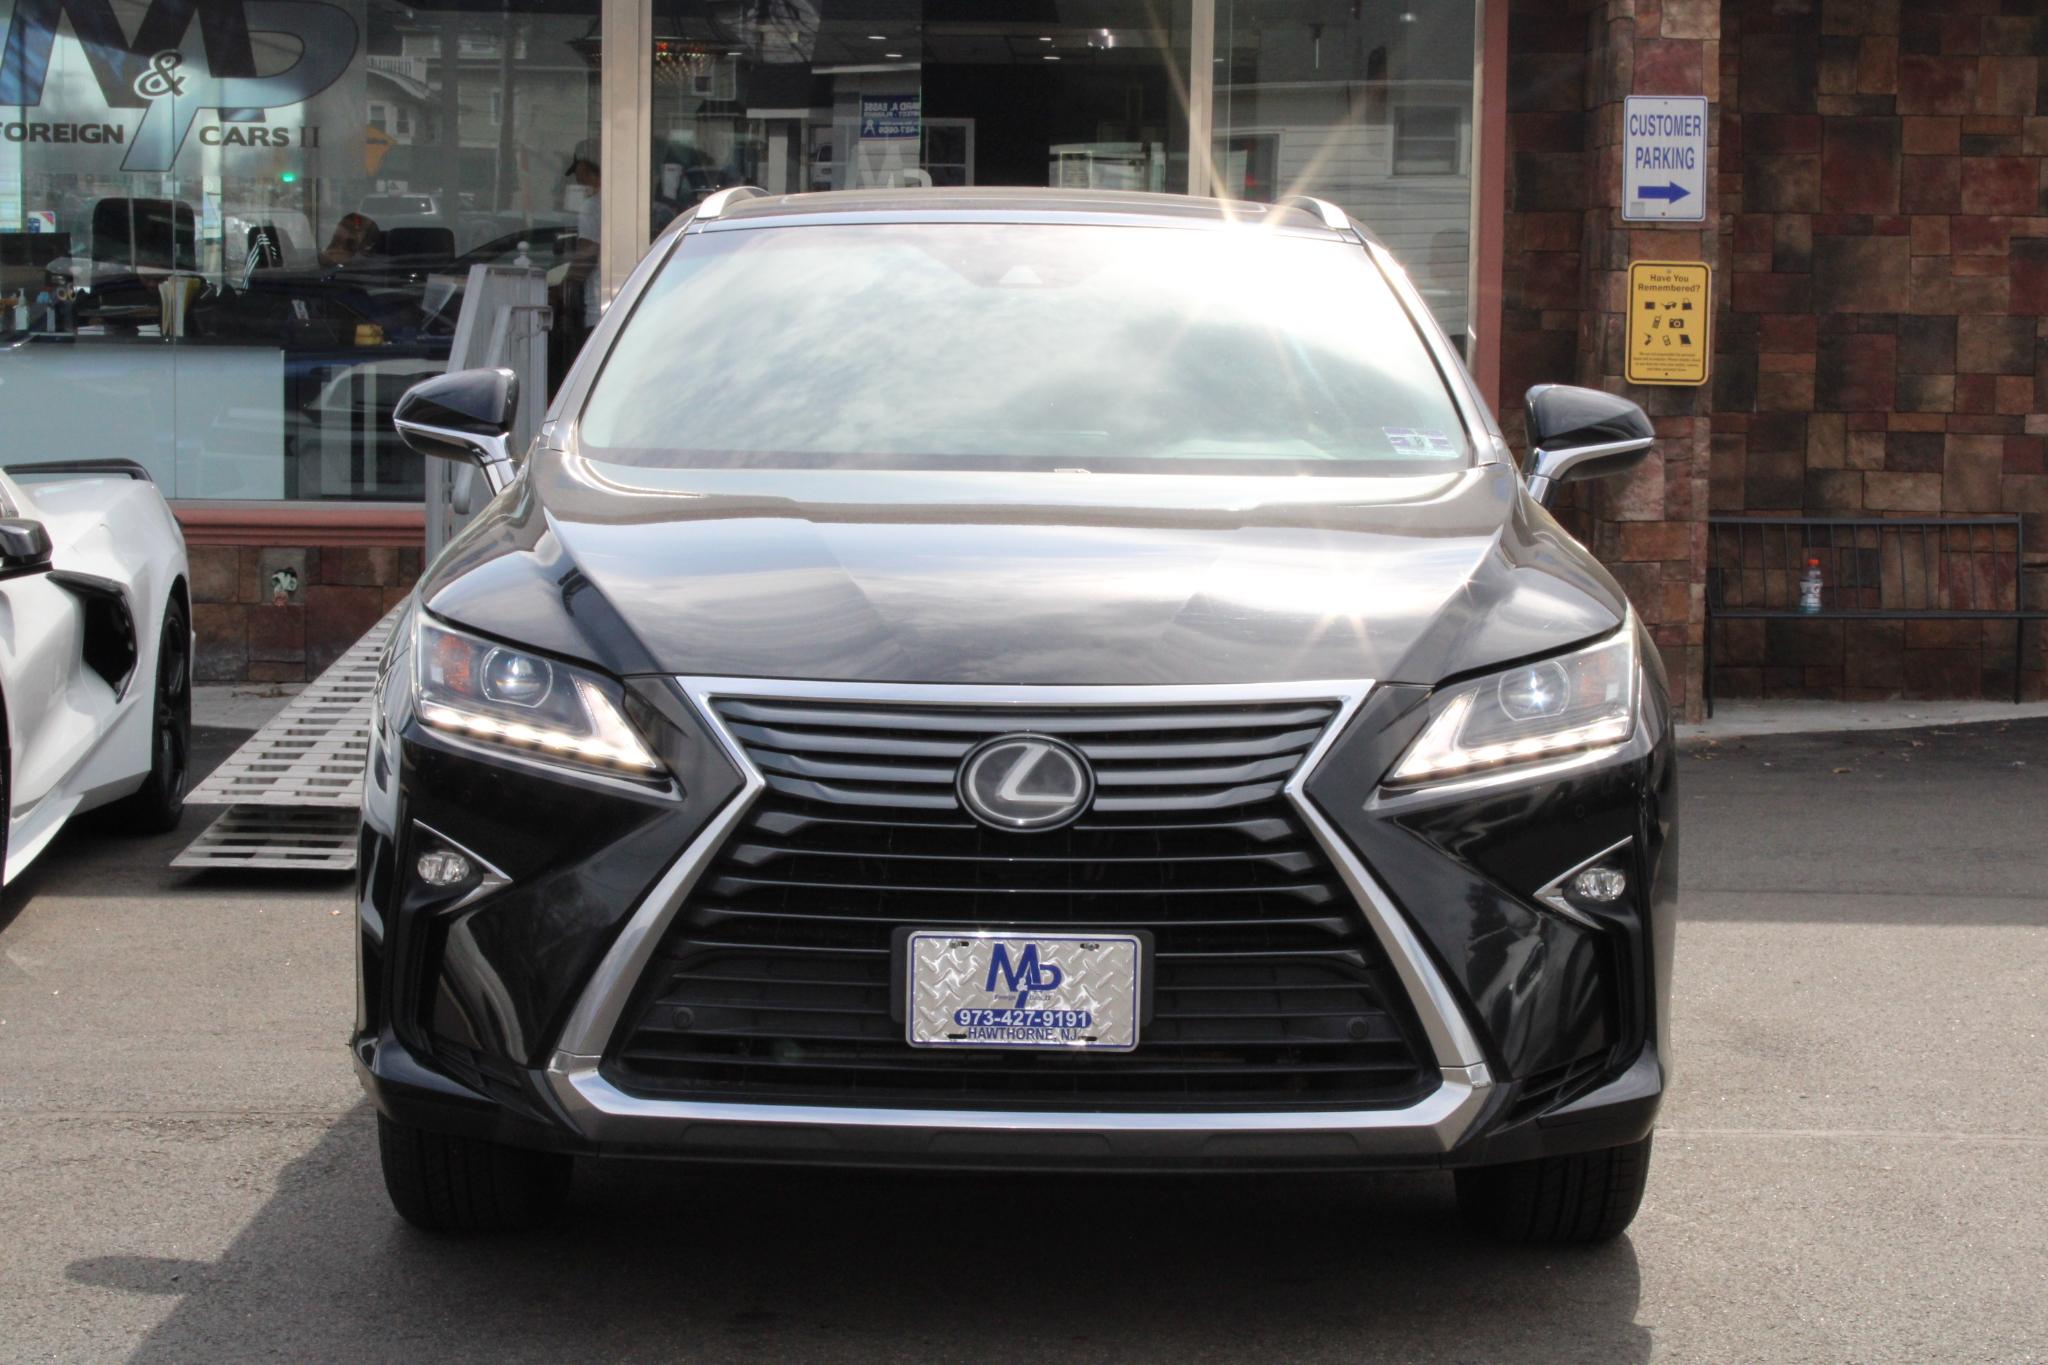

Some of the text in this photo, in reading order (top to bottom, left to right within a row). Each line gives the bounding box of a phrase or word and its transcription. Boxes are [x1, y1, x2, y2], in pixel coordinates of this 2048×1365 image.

[0, 122, 124, 144] OREIGN
[1629, 113, 1702, 137] CUSTOMER
[199, 126, 320, 148] CARS II
[1635, 146, 1695, 170] PARKING
[1637, 283, 1701, 293] Remembered?
[1650, 273, 1689, 282] Have You
[960, 1009, 1087, 1027] 973-427-9191
